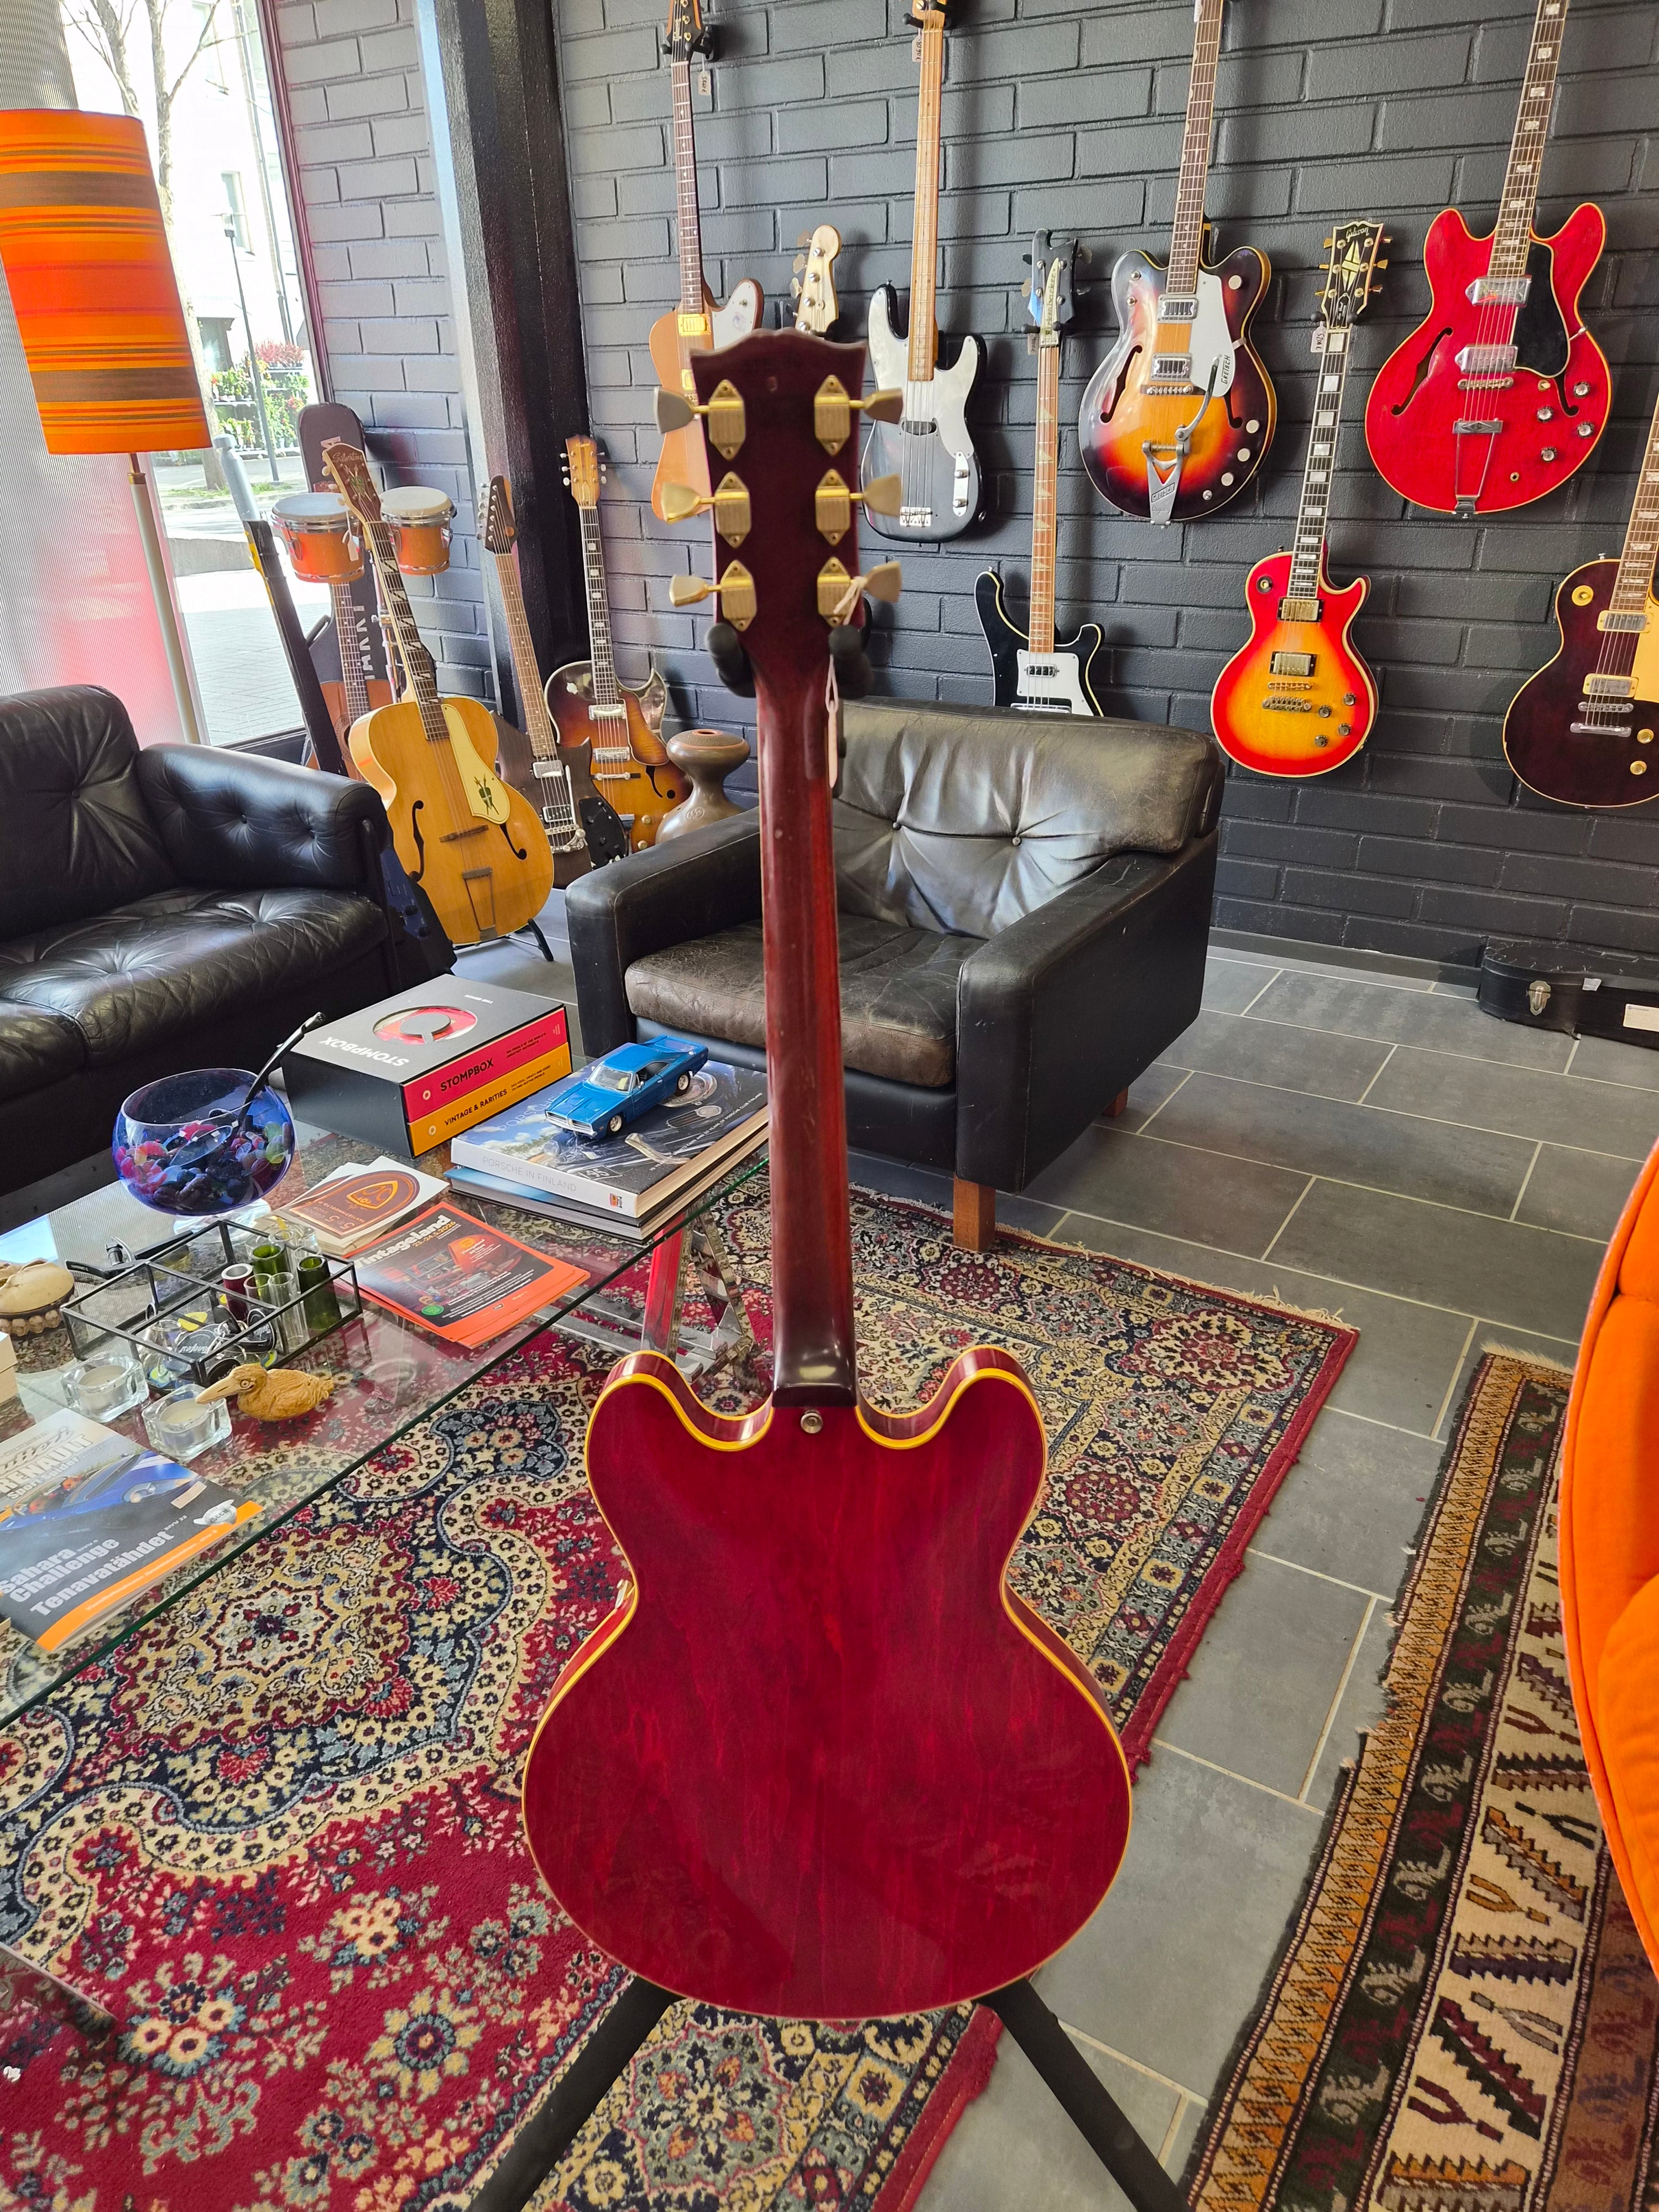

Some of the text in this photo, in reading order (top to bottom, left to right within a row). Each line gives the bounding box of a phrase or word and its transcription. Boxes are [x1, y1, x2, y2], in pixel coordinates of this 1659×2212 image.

[1345, 227, 1370, 242] Gibson
[1220, 354, 1231, 384] GRETSCH
[319, 1037, 409, 1066] STOMPBOX
[440, 1058, 494, 1092] STOMPBOX
[444, 1107, 473, 1126] VINTAGE
[479, 1088, 507, 1108] RARITIES
[483, 1156, 576, 1191] PORSCHE IN FINLAND
[354, 1214, 452, 1269] Vintageland
[0, 1433, 93, 1494] RENAULT
[7, 1477, 43, 1499] Sport
[43, 1455, 81, 1480] Spider
[0, 1547, 77, 1594] Sahara
[9, 1538, 121, 1603] Challenge
[30, 1530, 175, 1616] Tenavatähdet
